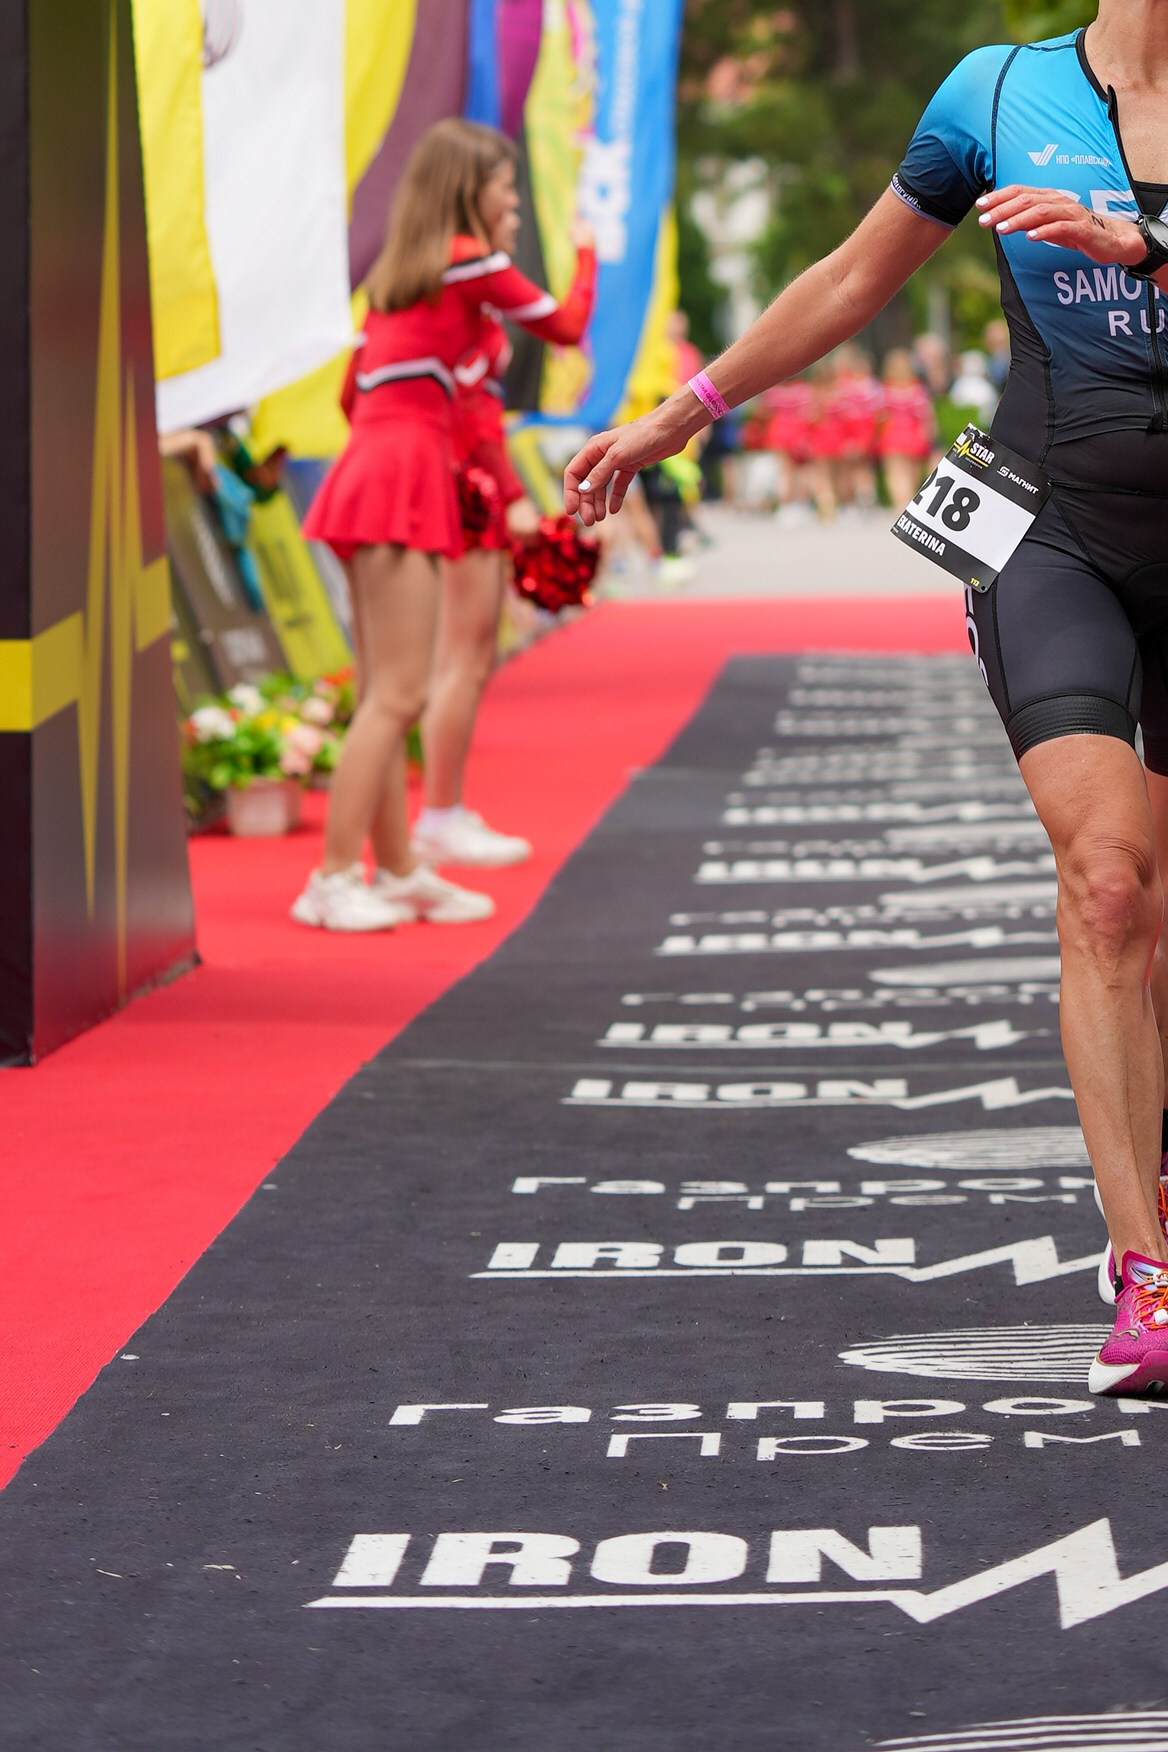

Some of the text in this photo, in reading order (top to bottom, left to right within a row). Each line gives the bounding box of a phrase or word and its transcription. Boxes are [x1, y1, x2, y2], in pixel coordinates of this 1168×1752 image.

[970, 442, 996, 465] STAR
[1008, 472, 1039, 494] МАГНИТ
[487, 1237, 916, 1269] IRON
[331, 1525, 923, 1587] IRON
